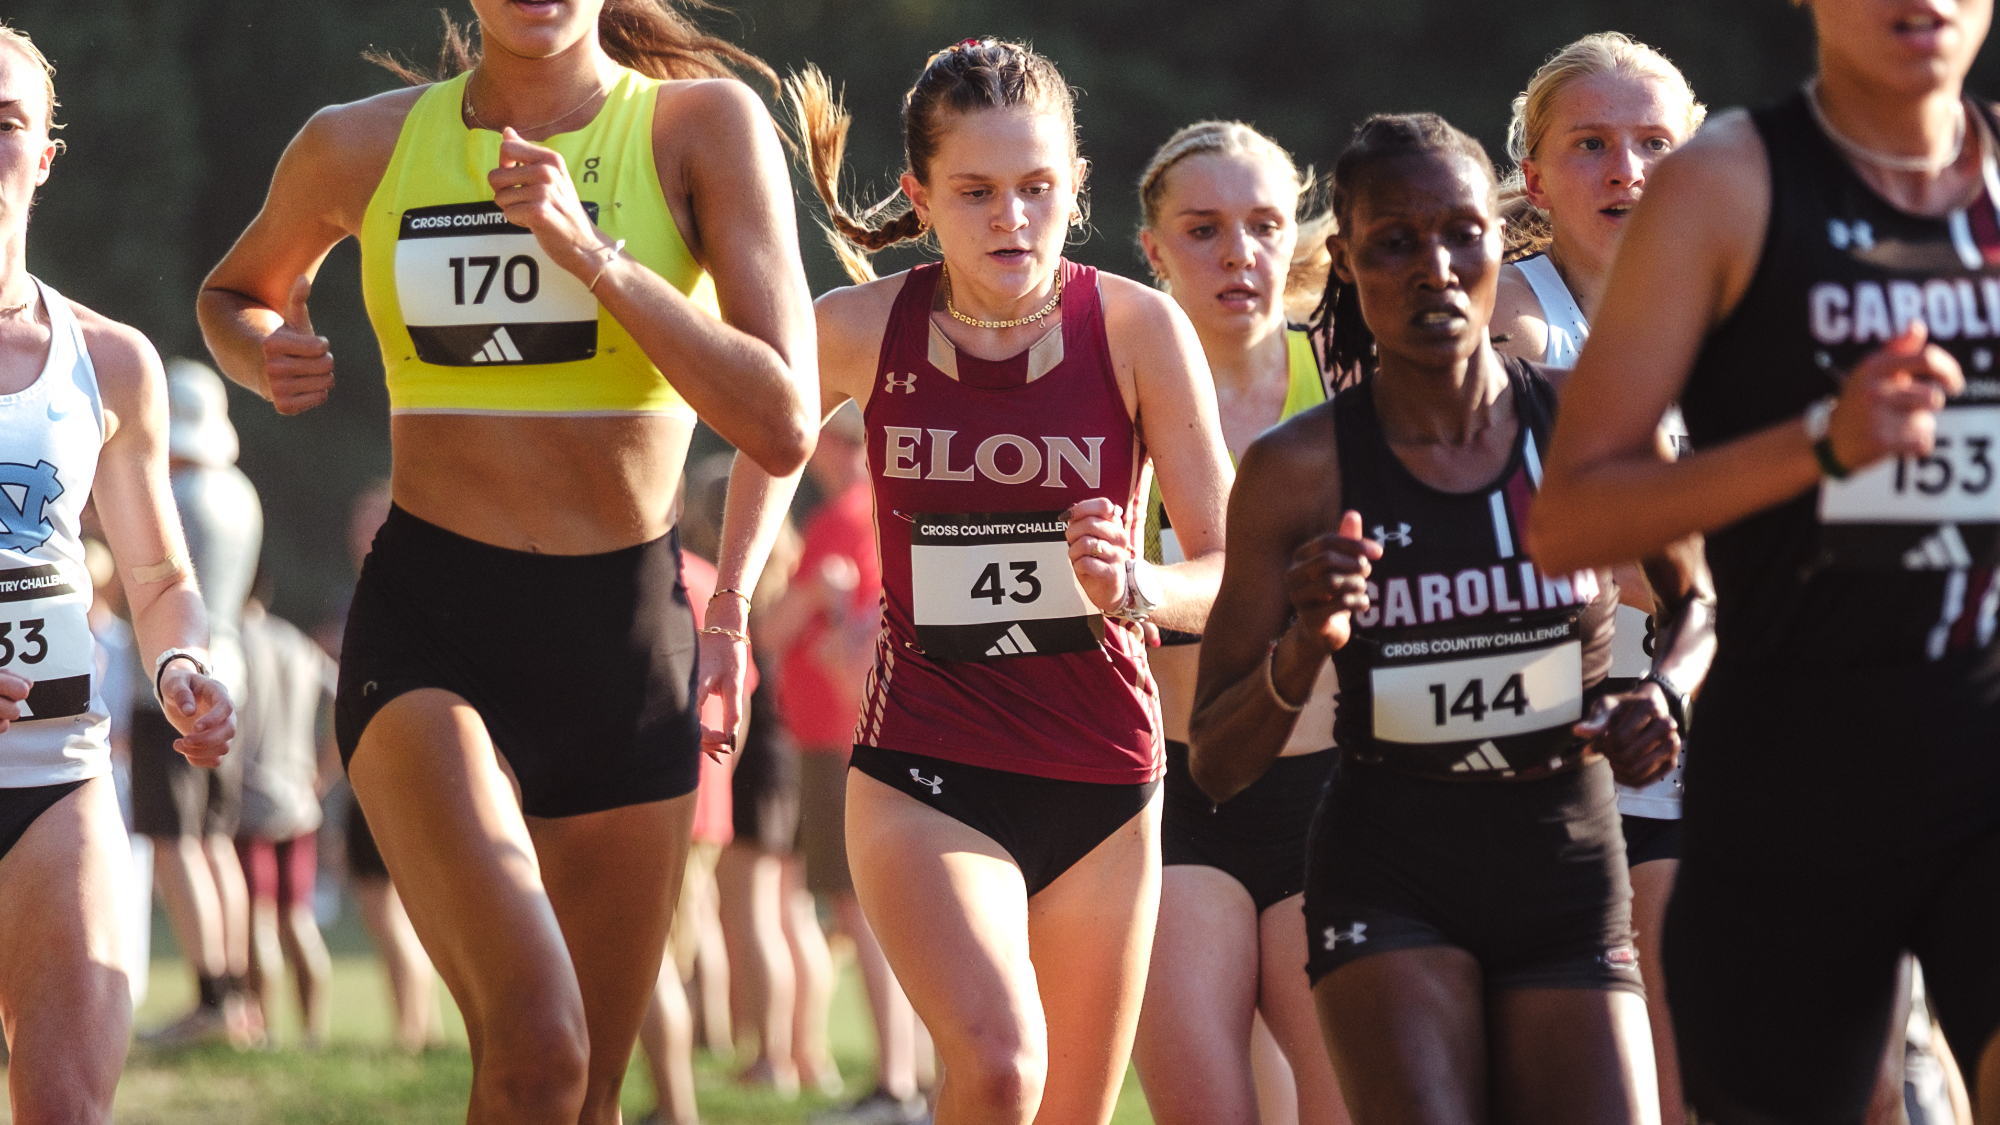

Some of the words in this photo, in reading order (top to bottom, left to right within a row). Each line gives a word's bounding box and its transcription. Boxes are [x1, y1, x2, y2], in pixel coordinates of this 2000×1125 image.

[411, 216, 451, 229] CROSS
[449, 255, 539, 305] 170
[883, 426, 1105, 488] ELON
[921, 524, 959, 536] CROSS
[960, 524, 1016, 536] COUNTRY
[1016, 521, 1070, 534] CHALLEN
[20, 574, 64, 590] CHALLE
[971, 561, 1041, 606] 43
[1384, 643, 1429, 658] CROSS
[1431, 635, 1494, 654] COUNTRY
[1494, 623, 1570, 647] CHALLENGE
[1429, 673, 1529, 726] 144
